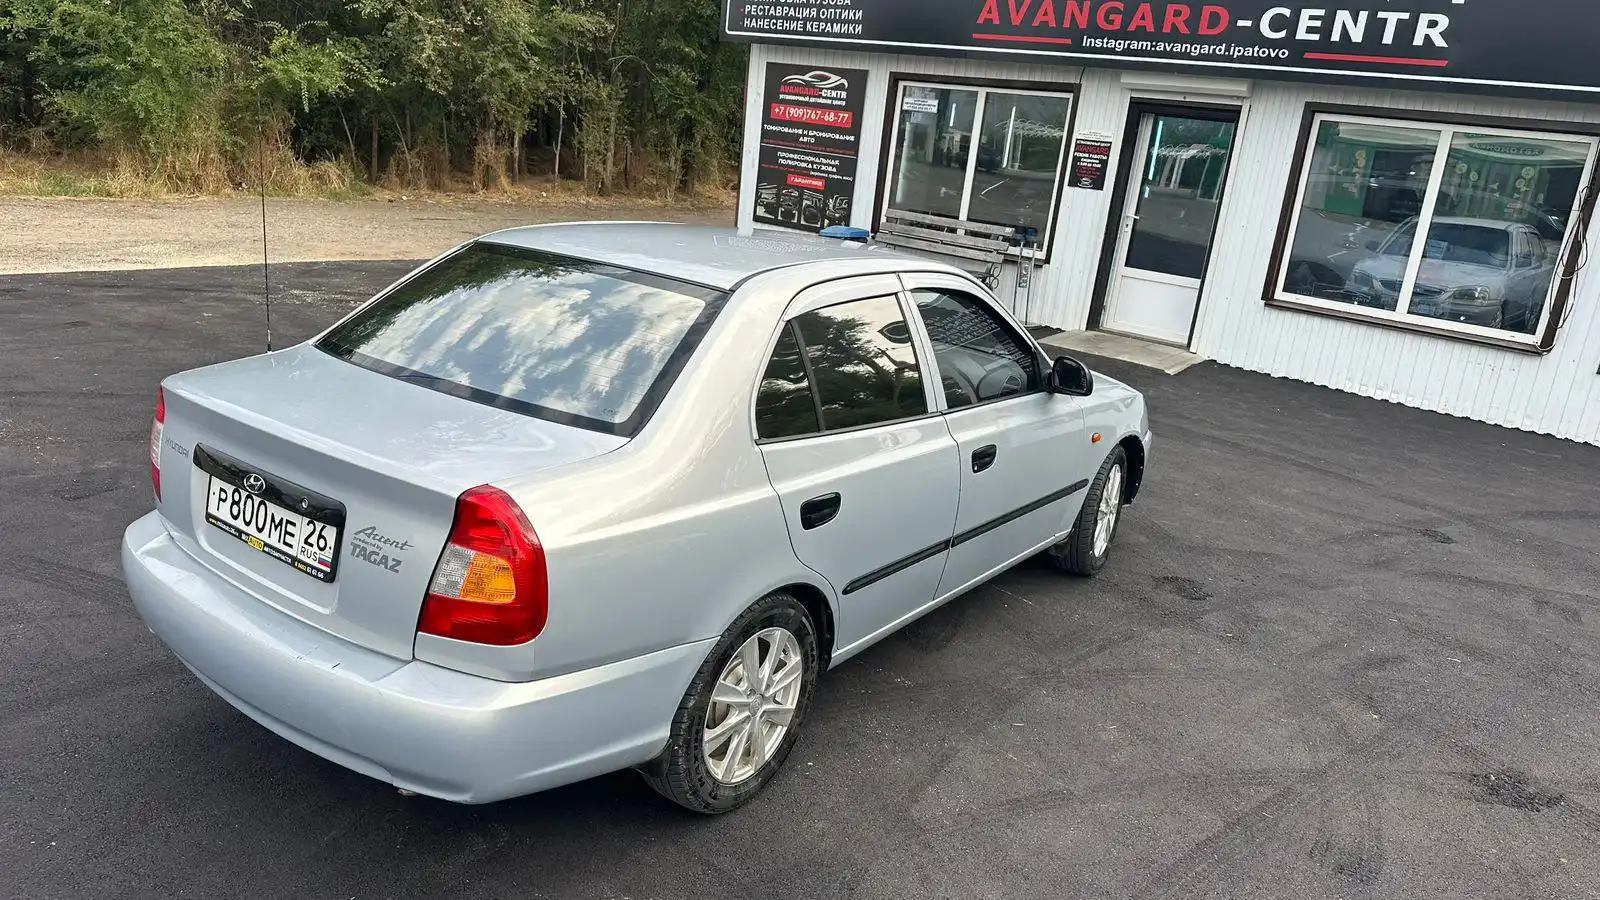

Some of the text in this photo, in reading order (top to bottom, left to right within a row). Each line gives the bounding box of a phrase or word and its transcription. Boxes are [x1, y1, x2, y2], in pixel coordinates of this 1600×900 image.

[745, 5, 863, 20] РЕСТАВРАЦИЯ ОПТИКИ
[744, 18, 863, 34] НАНЕСЕНИЕ КЕРАМИКИ
[976, 0, 1450, 48] AVANGARD-CENTR
[1082, 35, 1289, 59] Instagram:avangard.ipatovo
[780, 85, 847, 99] AVANGARD-CENTR
[774, 106, 849, 124] +7 (909)767-68-77
[763, 124, 803, 135] ТОНИРОВАНИЕ
[808, 130, 856, 141] БРОНИРОВАНИЕ
[777, 151, 840, 165] ПРОФЕССИОНАЛЬНАЯ
[778, 158, 812, 169] ПОЛИРОВКА
[813, 162, 837, 172] КУЗОВА
[303, 519, 328, 552] 26
[353, 526, 415, 551] Accent
[300, 545, 319, 563] RUS
[350, 541, 402, 573] TAGAZ
